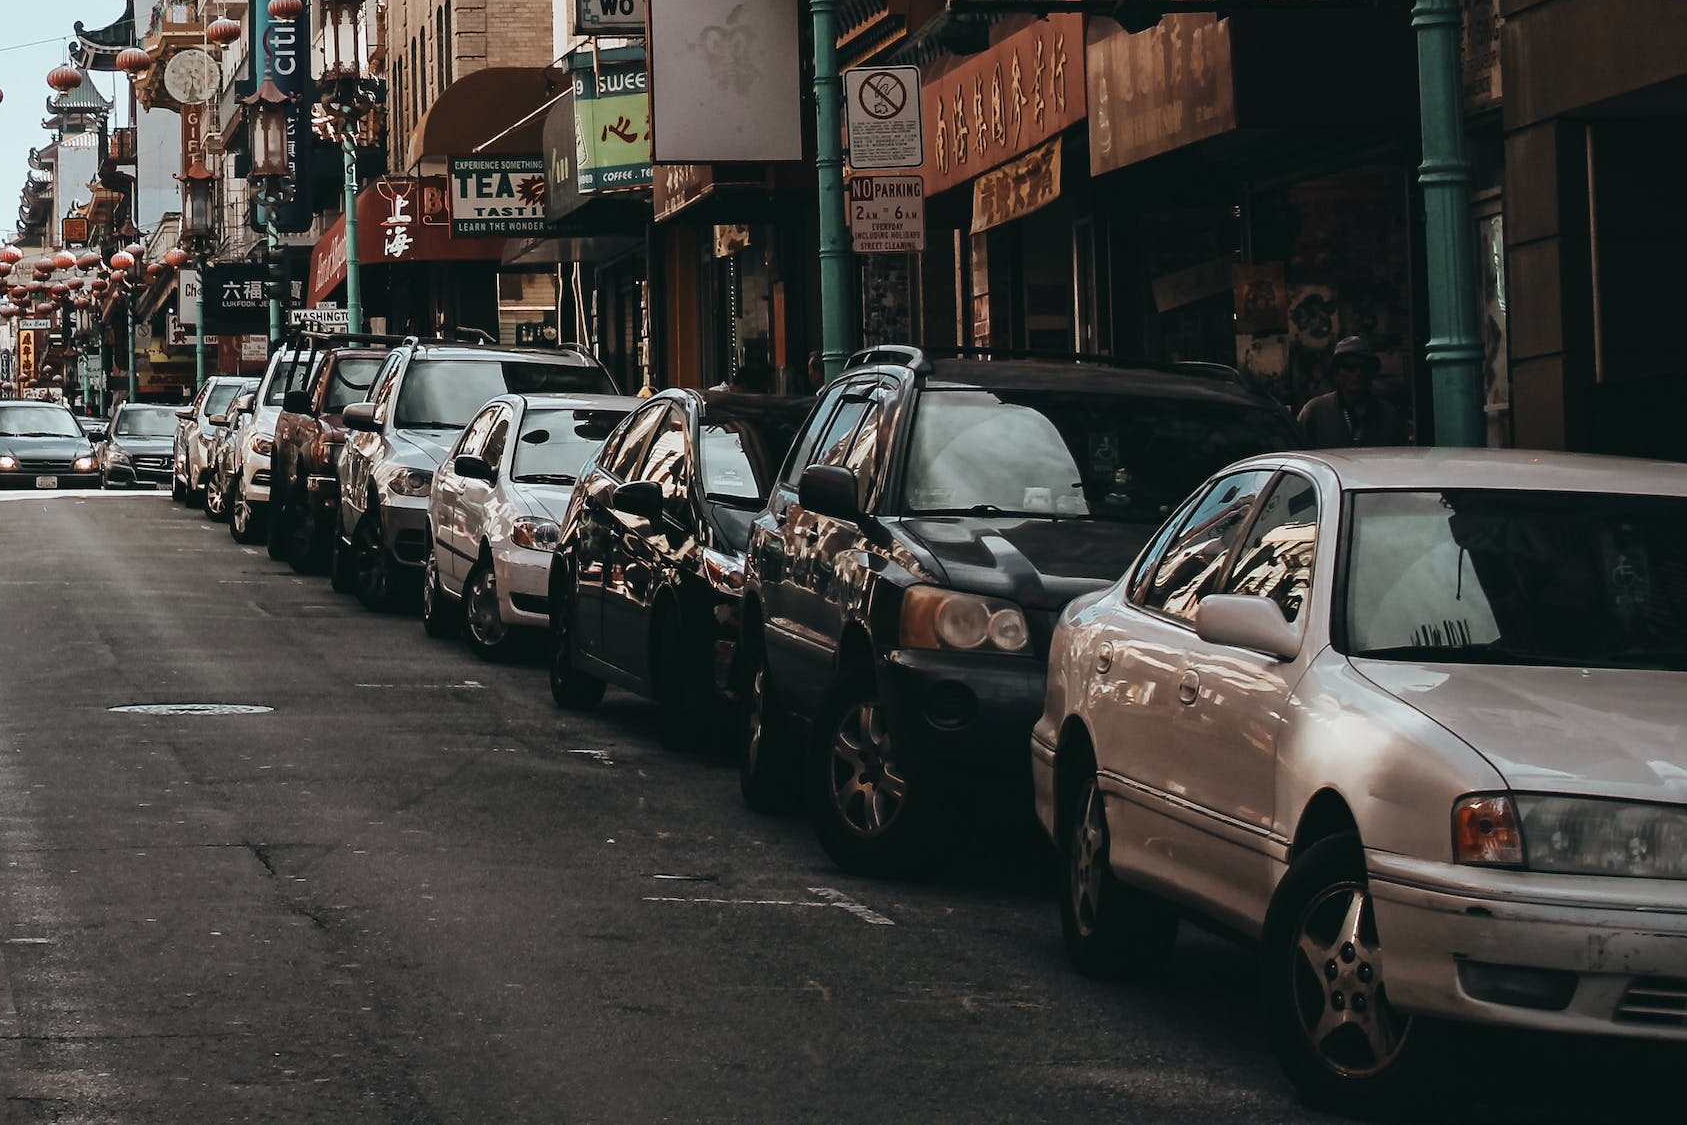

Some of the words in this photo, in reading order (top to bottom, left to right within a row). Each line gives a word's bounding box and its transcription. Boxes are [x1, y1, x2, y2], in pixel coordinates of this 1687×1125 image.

[599, 73, 648, 93] SWEE
[454, 160, 499, 170] EXPERIENCE
[500, 160, 544, 170] SOMETHING
[603, 170, 633, 182] COFFEE
[454, 174, 515, 199] TEA
[852, 179, 872, 198] NO
[874, 182, 920, 198] PARKING
[856, 206, 864, 220] 2
[895, 206, 903, 220] 6
[384, 194, 414, 257] 上海
[458, 222, 486, 232] LEARN
[490, 222, 505, 231] THE
[872, 223, 904, 231] EVERYDAY
[891, 231, 920, 239] HOLIDAYS
[861, 242, 882, 250] STREET
[293, 311, 349, 322] WASHINGT
